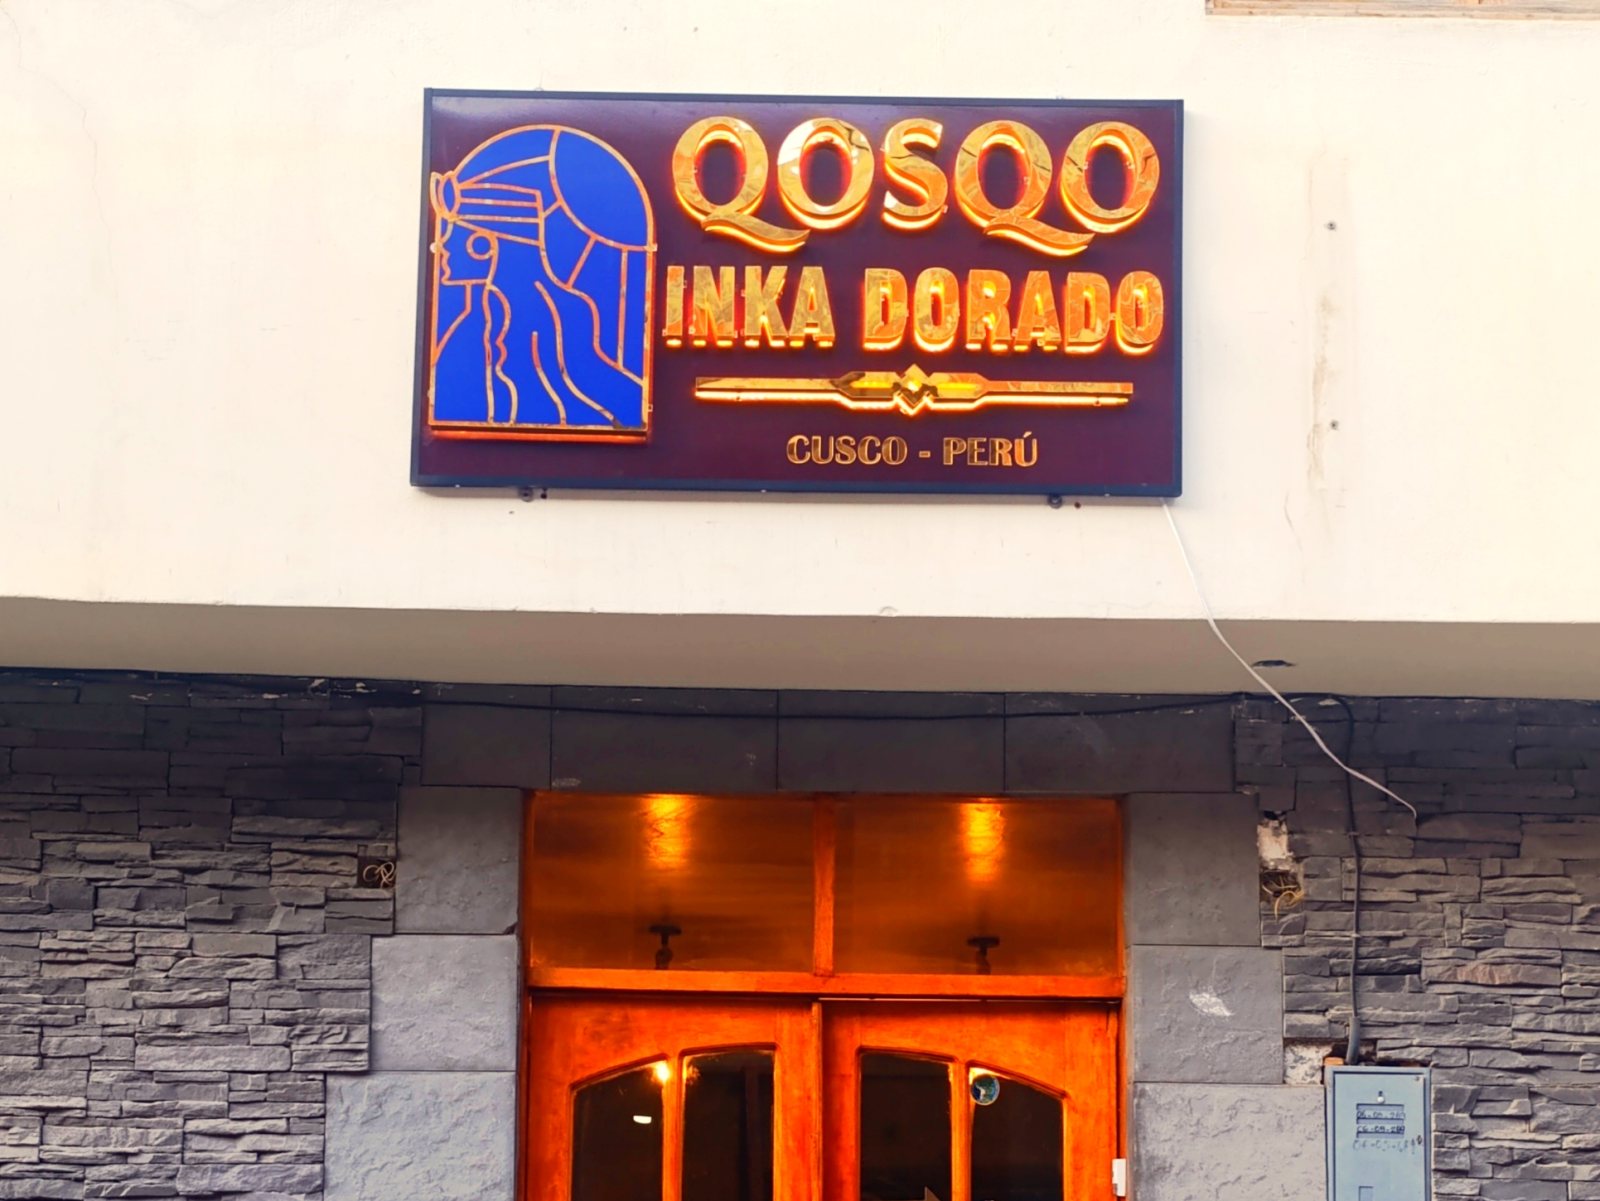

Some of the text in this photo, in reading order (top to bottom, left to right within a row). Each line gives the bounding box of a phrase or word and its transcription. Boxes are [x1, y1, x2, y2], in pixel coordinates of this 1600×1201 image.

[672, 116, 1160, 256] QOSQO
[663, 265, 1164, 354] INKA DORADO
[786, 434, 907, 465] CUSCO
[943, 431, 1038, 467] PERÚ
